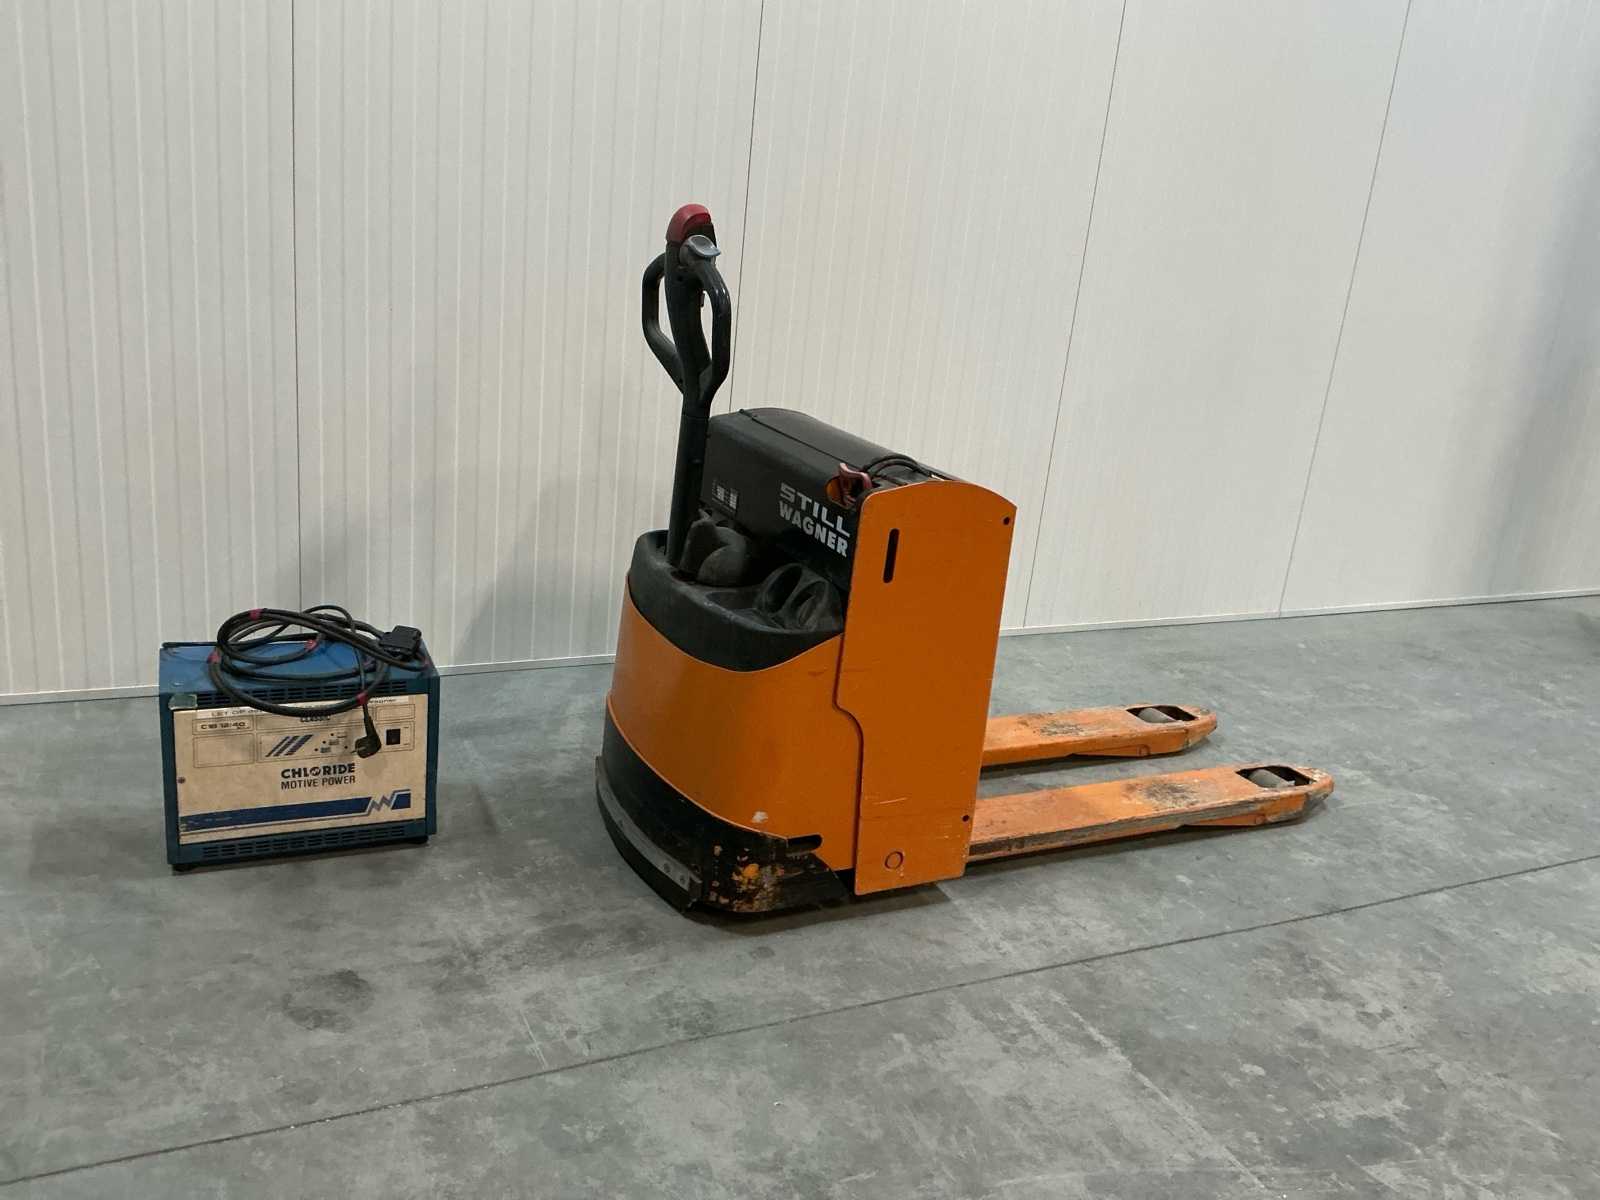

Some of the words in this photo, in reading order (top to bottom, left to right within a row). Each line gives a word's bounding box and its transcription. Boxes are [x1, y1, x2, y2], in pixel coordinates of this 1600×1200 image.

[779, 482, 850, 538] STILL
[779, 500, 848, 557] WAGNER
[281, 763, 355, 779] CHLORIDE
[281, 779, 318, 790] MOTIVE
[321, 775, 356, 786] POWER
